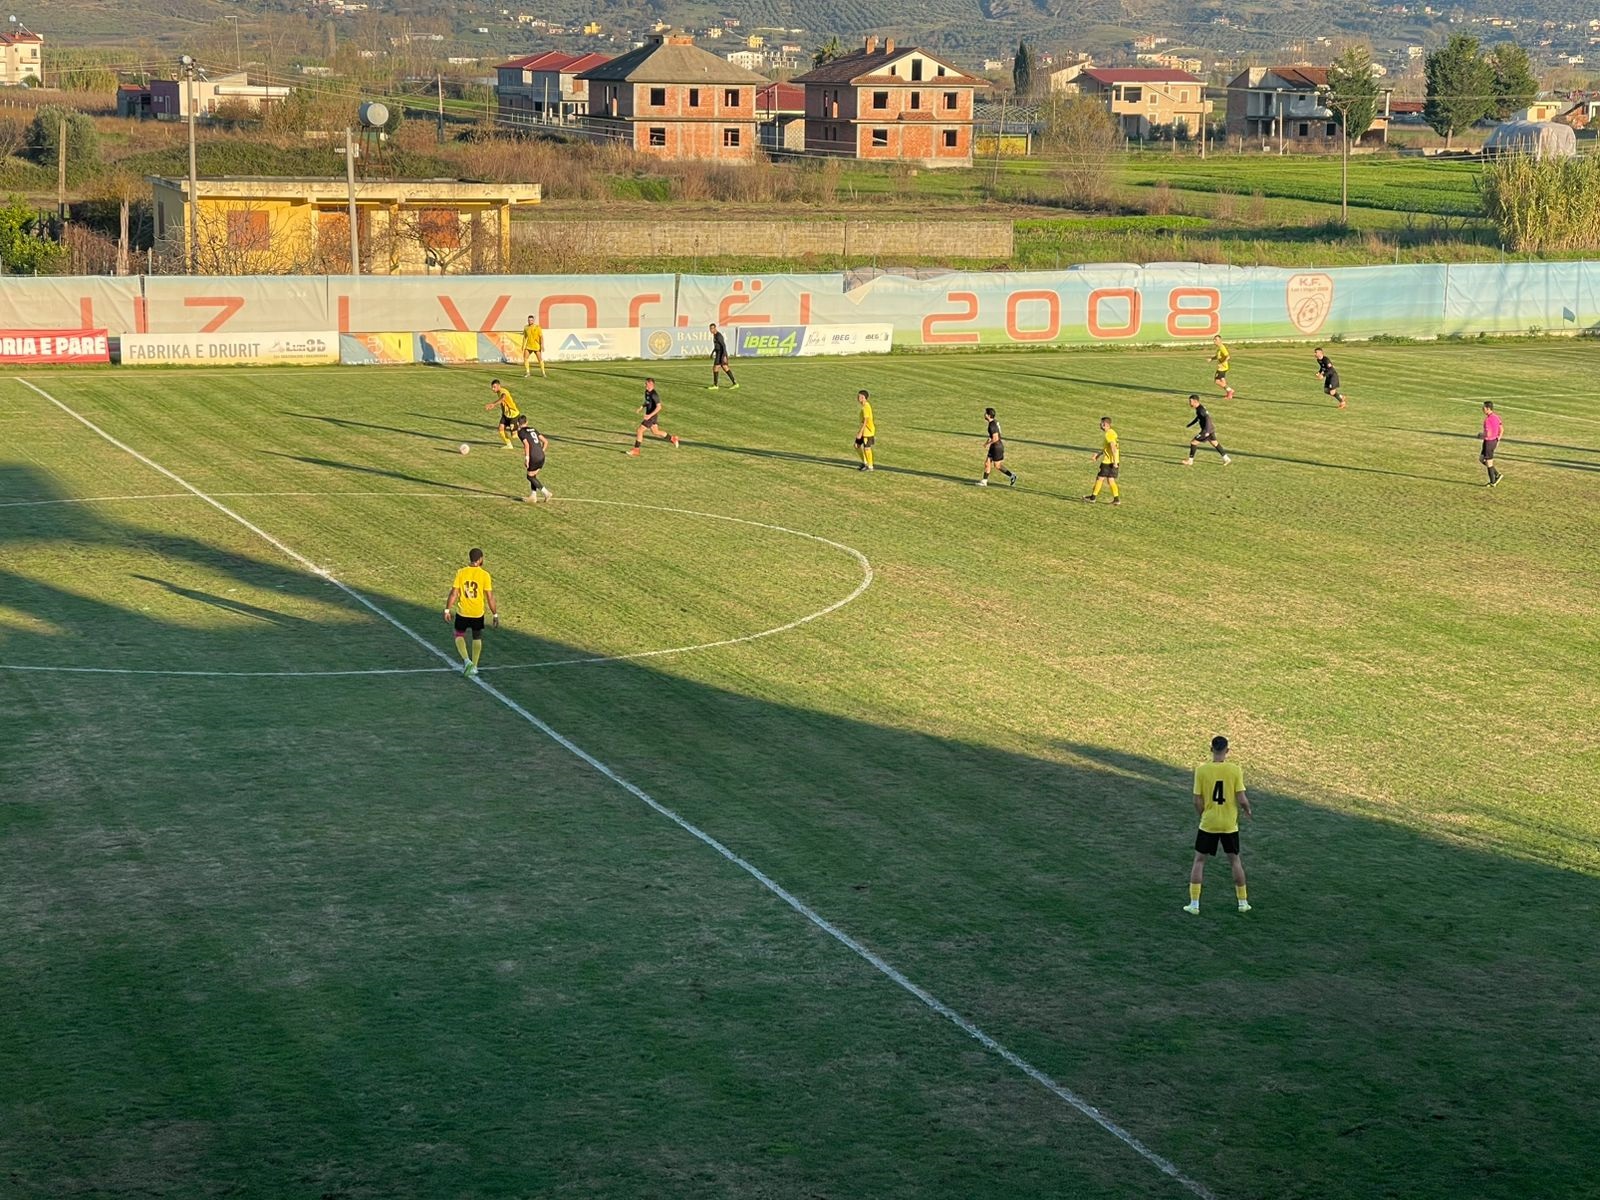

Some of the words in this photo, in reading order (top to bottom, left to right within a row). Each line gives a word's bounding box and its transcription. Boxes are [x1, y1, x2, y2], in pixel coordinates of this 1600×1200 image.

[921, 287, 1221, 344] 2008
[40, 337, 52, 355] E
[129, 343, 191, 359] FABRIKA
[196, 344, 204, 358] E
[209, 343, 261, 358] DRURIT
[530, 431, 539, 444] 9
[464, 580, 479, 599] 13
[1212, 780, 1226, 805] 4
